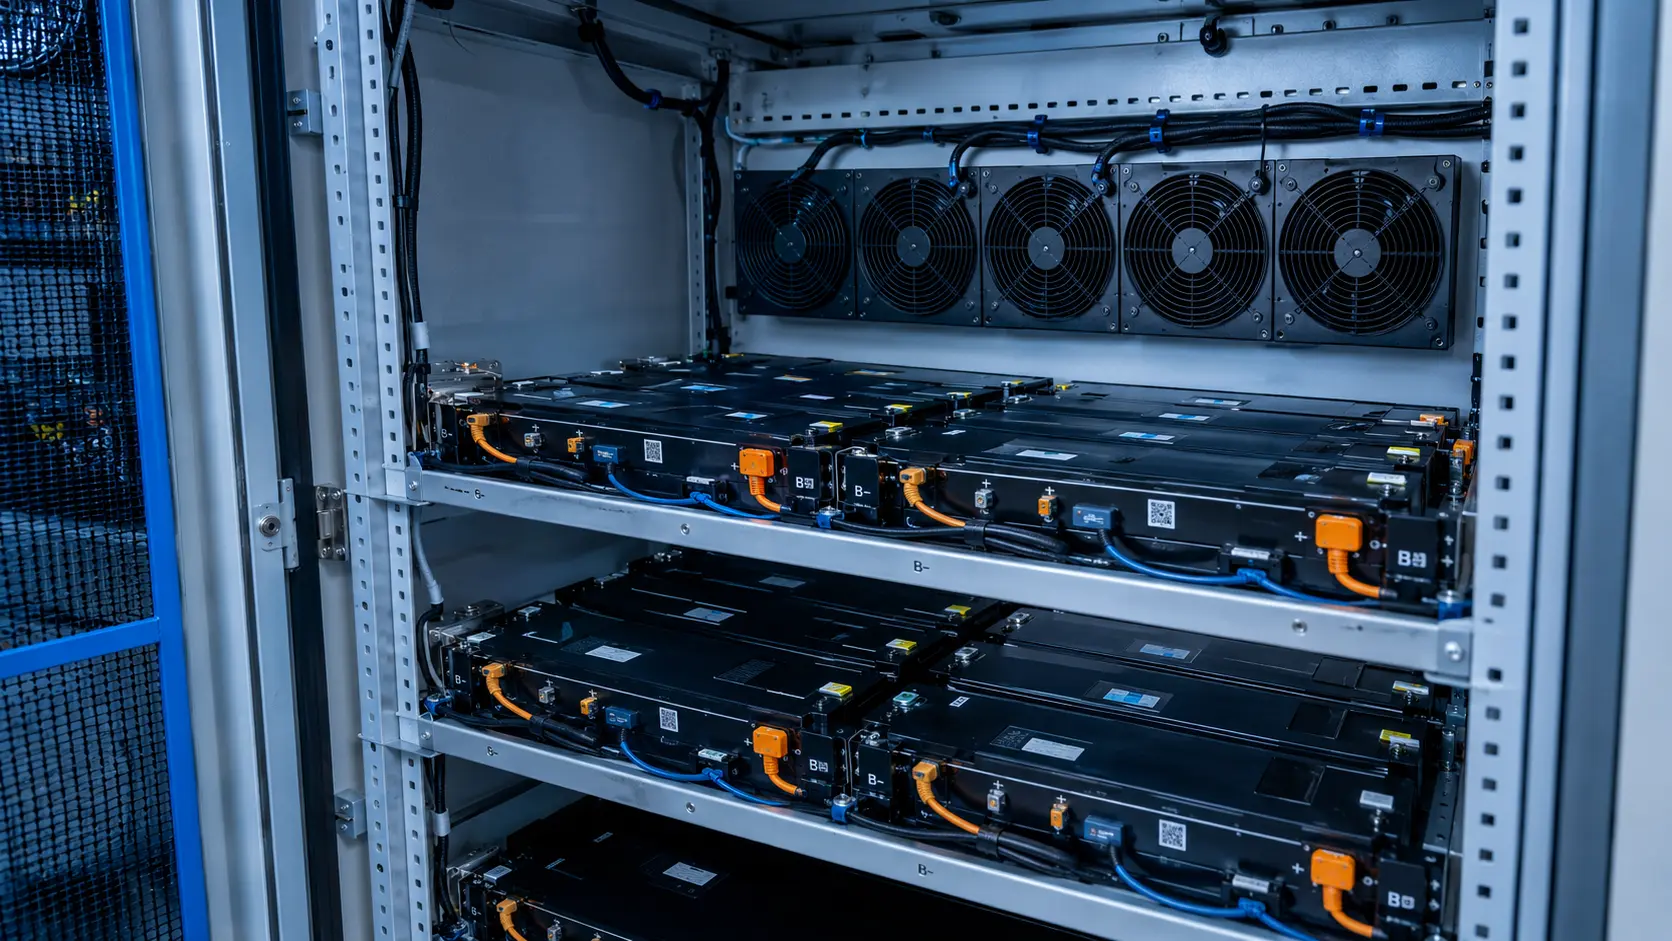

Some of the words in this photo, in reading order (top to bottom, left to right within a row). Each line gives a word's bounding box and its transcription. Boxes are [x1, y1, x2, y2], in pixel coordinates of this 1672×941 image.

[854, 485, 871, 497] B-
[913, 560, 930, 573] B-
[868, 774, 885, 785] B-
[918, 863, 934, 876] B-
